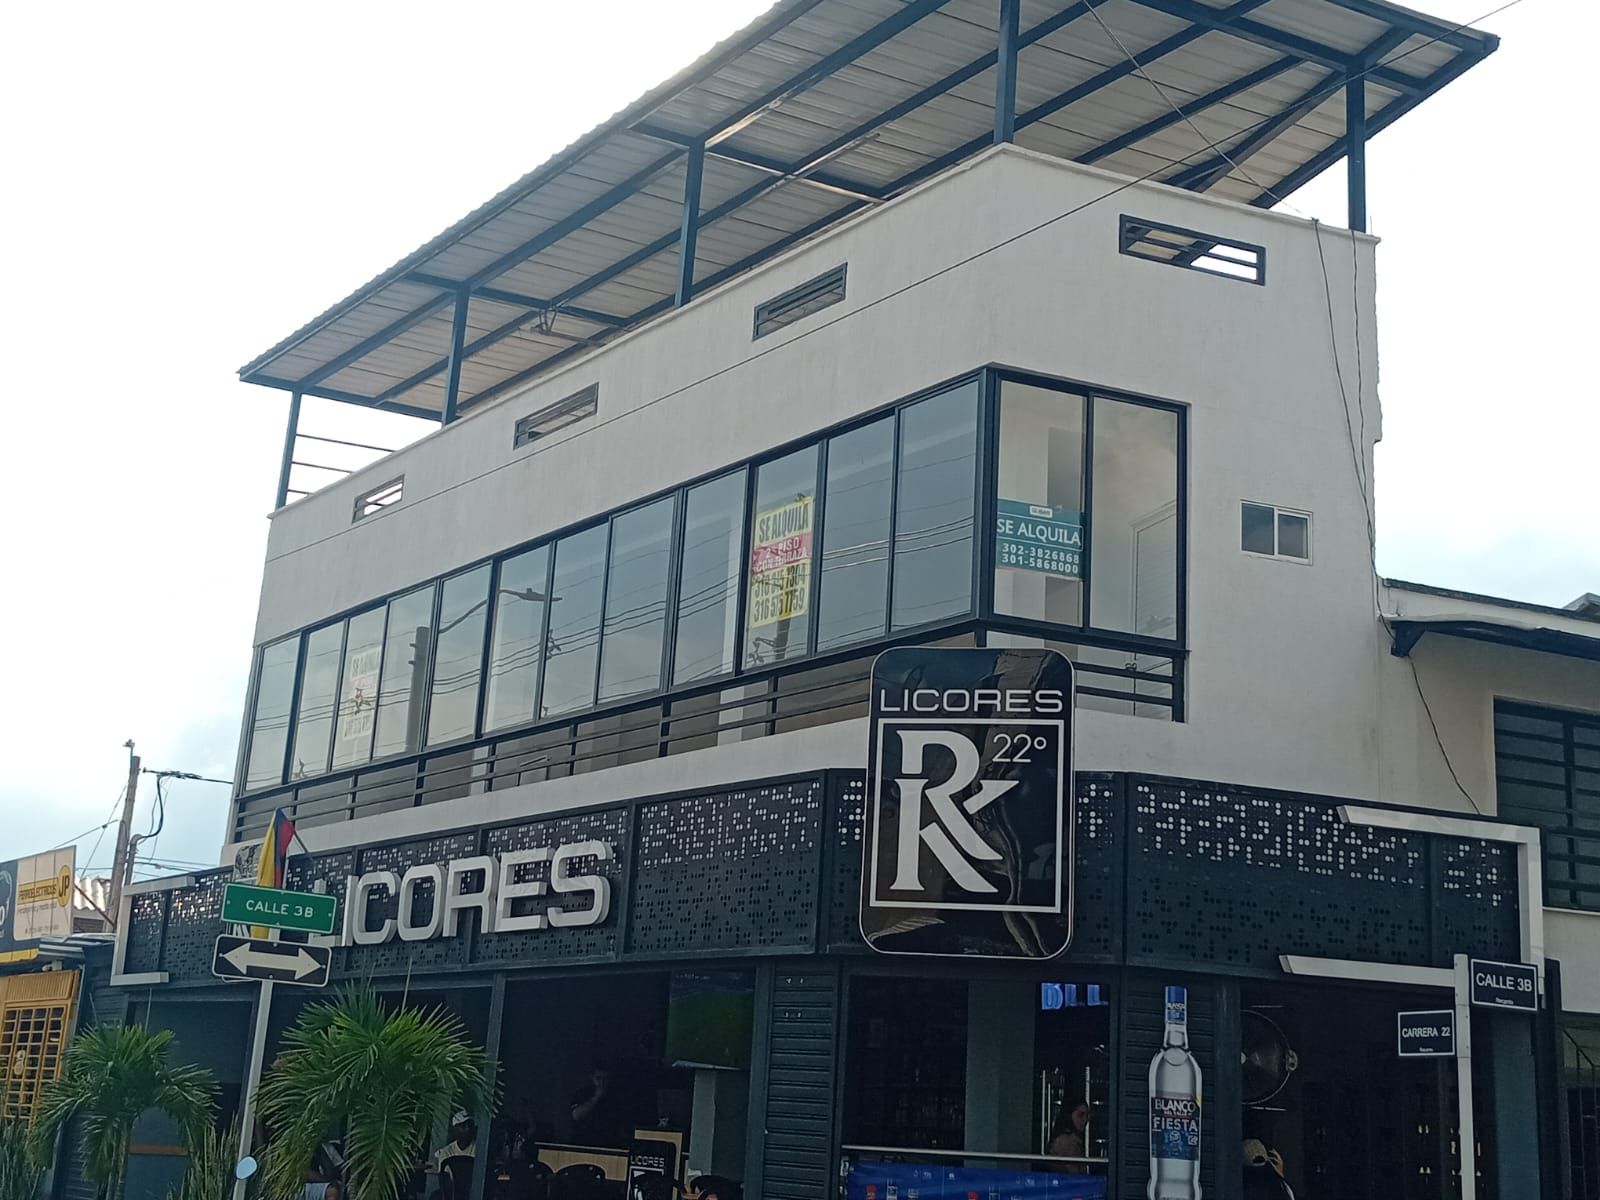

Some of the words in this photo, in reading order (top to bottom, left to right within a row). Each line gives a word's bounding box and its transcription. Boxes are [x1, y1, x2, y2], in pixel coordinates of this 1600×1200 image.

[759, 516, 771, 544] SE
[772, 503, 809, 540] ALQUILA
[996, 519, 1014, 535] SE
[1017, 522, 1081, 546] ALQUILA
[1002, 543, 1080, 564] 302-3826868
[1002, 554, 1079, 574] 301-5868000
[880, 688, 1063, 713] LICORES
[58, 875, 70, 897] JP
[246, 900, 290, 916] CALLE
[294, 905, 314, 918] 3B
[1476, 972, 1515, 991] CALLE
[1517, 976, 1533, 993] 3B
[1402, 1026, 1438, 1038] CARRERA
[1441, 1026, 1451, 1037] 22
[1154, 1098, 1196, 1113] BLANCO
[1153, 1117, 1198, 1133] FIESTA
[630, 1154, 665, 1168] LICORES
